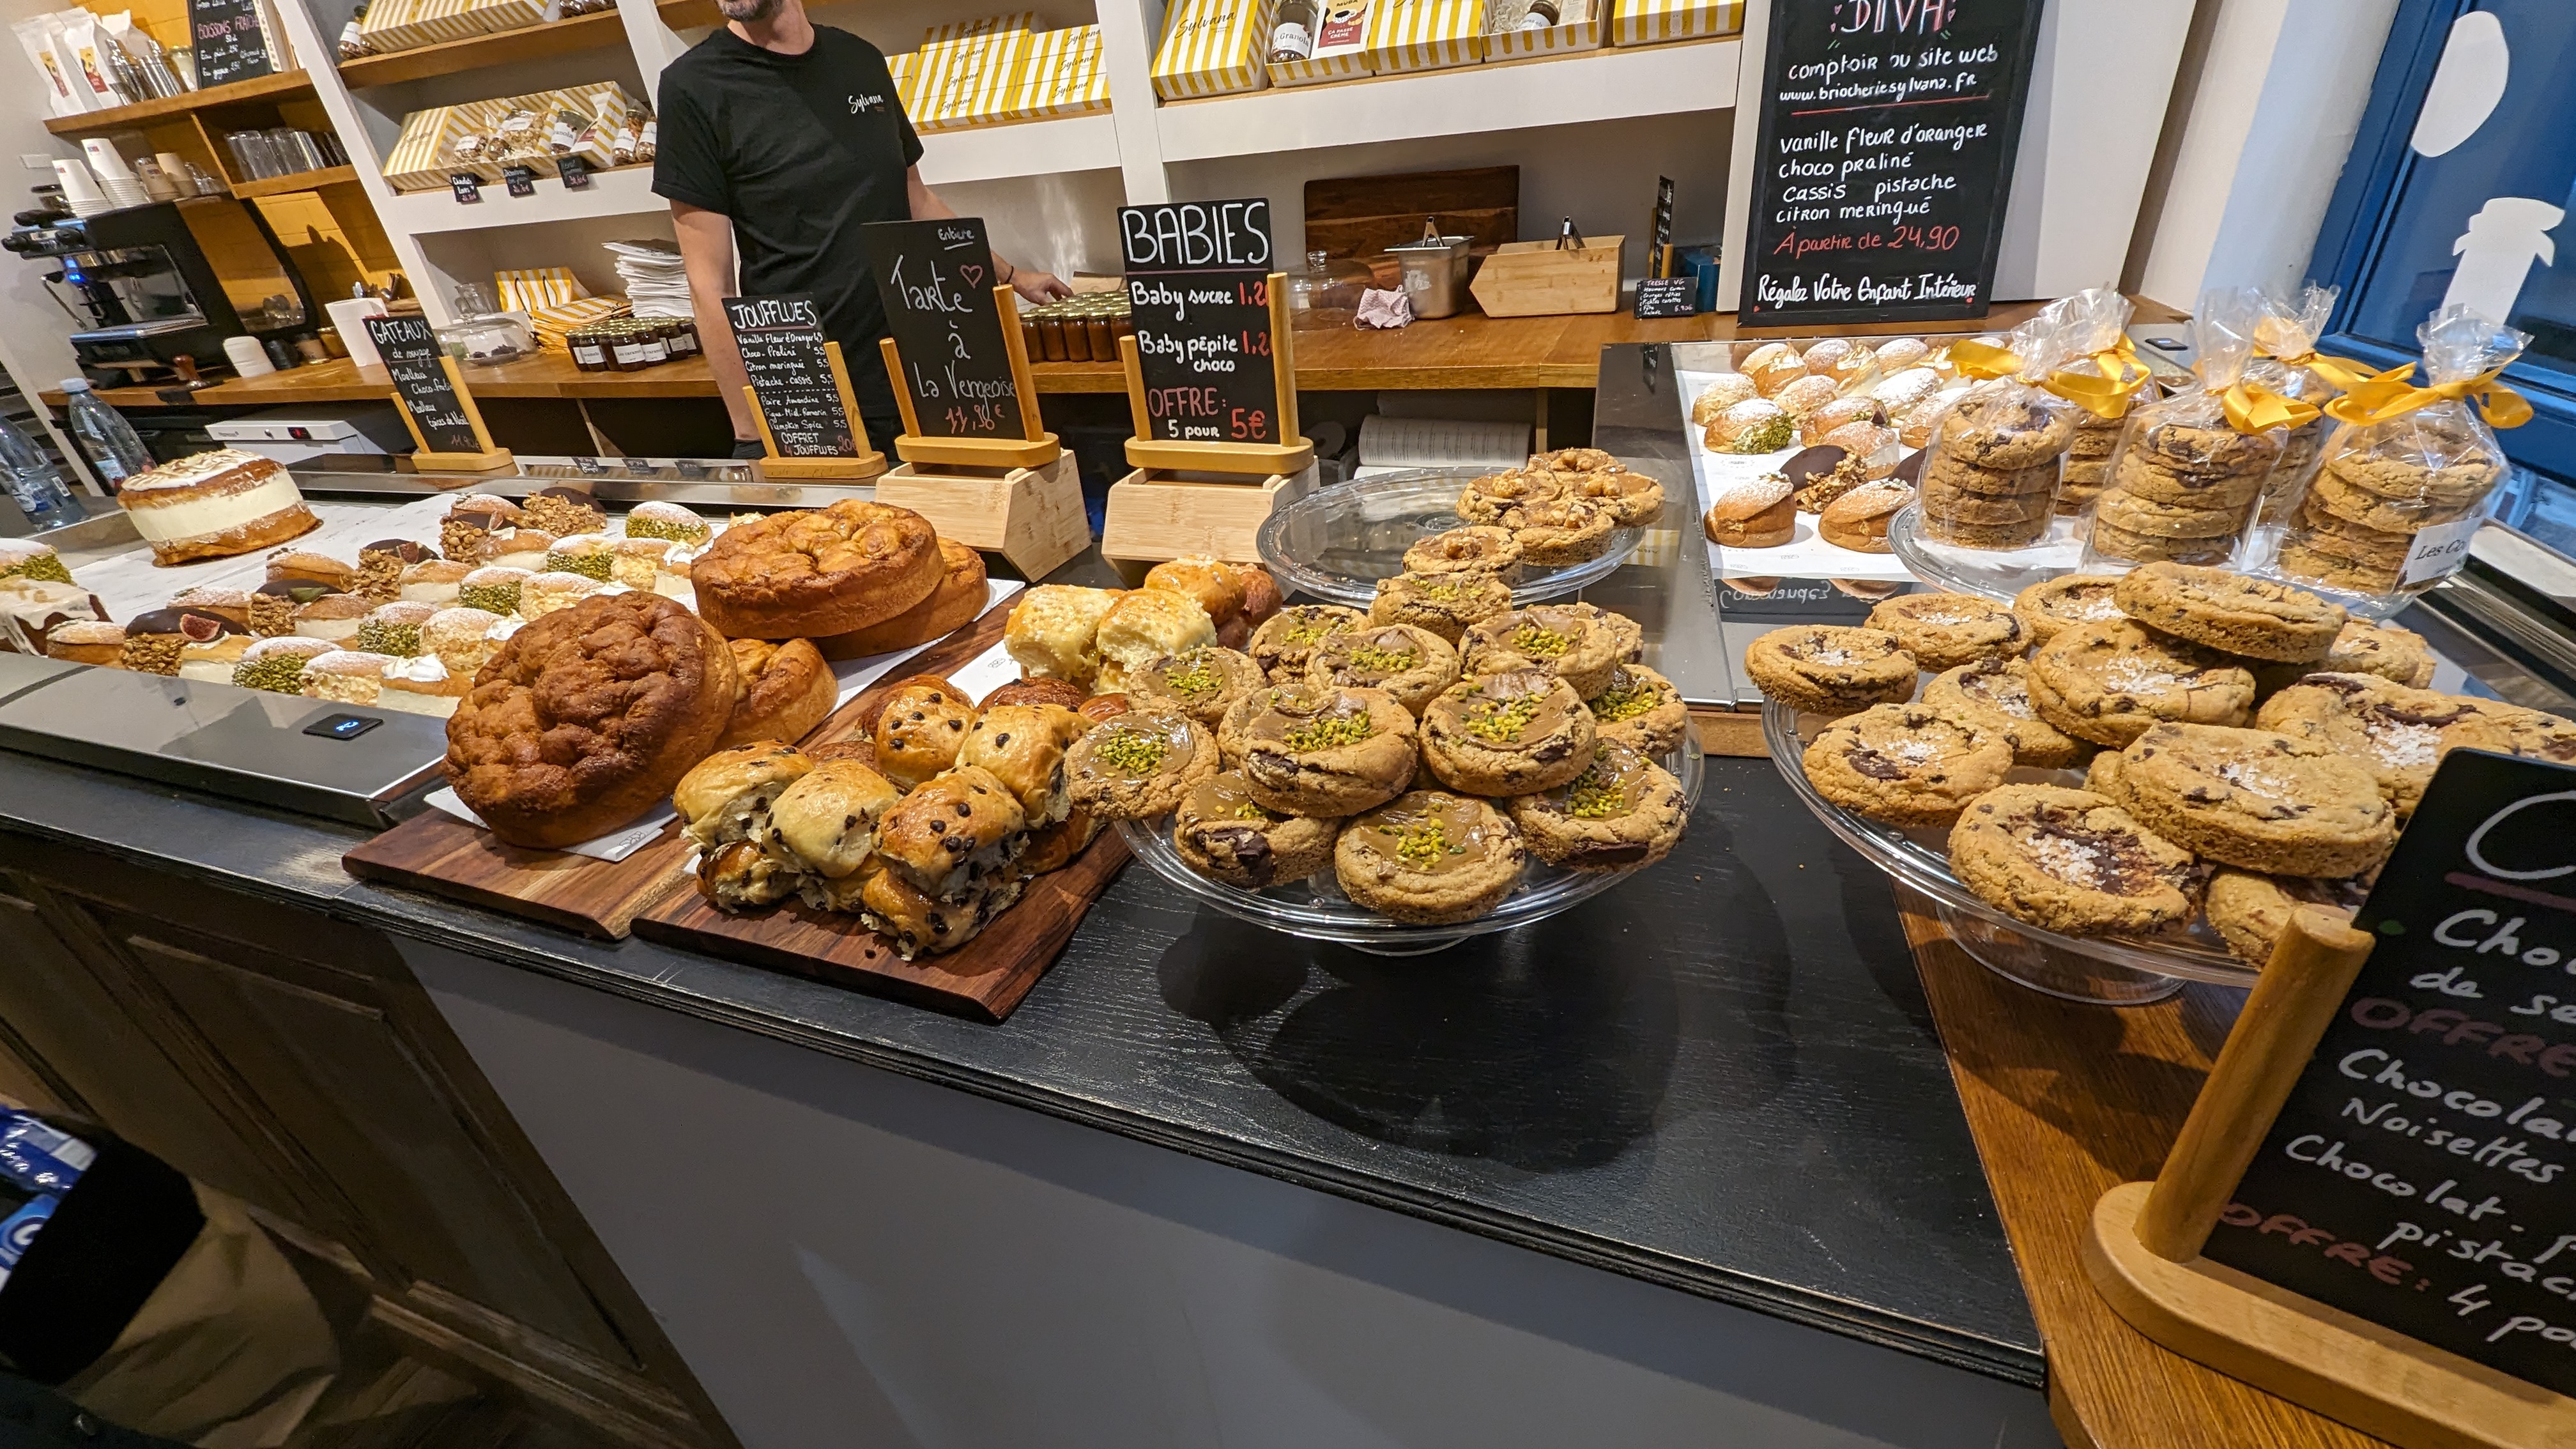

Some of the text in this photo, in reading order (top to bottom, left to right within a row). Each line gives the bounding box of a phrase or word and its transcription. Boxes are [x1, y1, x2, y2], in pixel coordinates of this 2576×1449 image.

[1174, 12, 1236, 38] Sylvana
[1841, 0, 1945, 34] DIVA
[1064, 28, 1101, 47] Sylvana
[1280, 33, 1309, 47] Granola
[952, 46, 985, 64] Sylvana
[1057, 55, 1094, 72] Sylvana
[1890, 55, 1911, 68] ou
[1919, 47, 1953, 66] site
[1959, 44, 1998, 63] web
[945, 72, 979, 88] Sylvana
[1052, 80, 1089, 98] Sylvana
[848, 93, 884, 114] Sylvana
[939, 96, 972, 113] Sylvana
[1779, 152, 1913, 181] choco praliné
[1874, 174, 1957, 202] pistache
[1776, 196, 1932, 226] citron meringué
[1122, 202, 1269, 264] BABIES
[1796, 236, 1851, 259] partir
[1858, 233, 1882, 249] de
[891, 254, 974, 312] Tarte
[1758, 274, 1808, 309] Régalez
[1814, 272, 1852, 301] Votre
[1913, 273, 1977, 300] Intérieur
[1131, 281, 1185, 321] Baby
[1188, 289, 1234, 305] sucre
[731, 300, 817, 329] JOUFFLUES
[370, 320, 433, 344] GATEAUX
[737, 334, 764, 344] Vanille
[765, 334, 785, 343] Fleur
[947, 320, 971, 359] à
[392, 348, 403, 358] de
[767, 345, 797, 357] Praliné
[1138, 330, 1272, 364] Baby pépite 1.2
[745, 360, 767, 371] Citron
[1193, 359, 1236, 372] choco
[751, 375, 785, 387] Pistache
[945, 360, 1016, 420] Vergeoise
[761, 394, 839, 406] Poire Amandine 5,5
[831, 407, 845, 416] 5,5
[769, 418, 847, 431] Pumpkin Spice 5,5
[1168, 408, 1267, 440] 5 pour 5€
[781, 433, 819, 444] COFFRET
[2414, 545, 2444, 560] Les
[2409, 966, 2484, 999] de
[2341, 1096, 2564, 1183] Noisettes
[2376, 1222, 2576, 1301] pistac
[2448, 1284, 2576, 1351] 4 po
